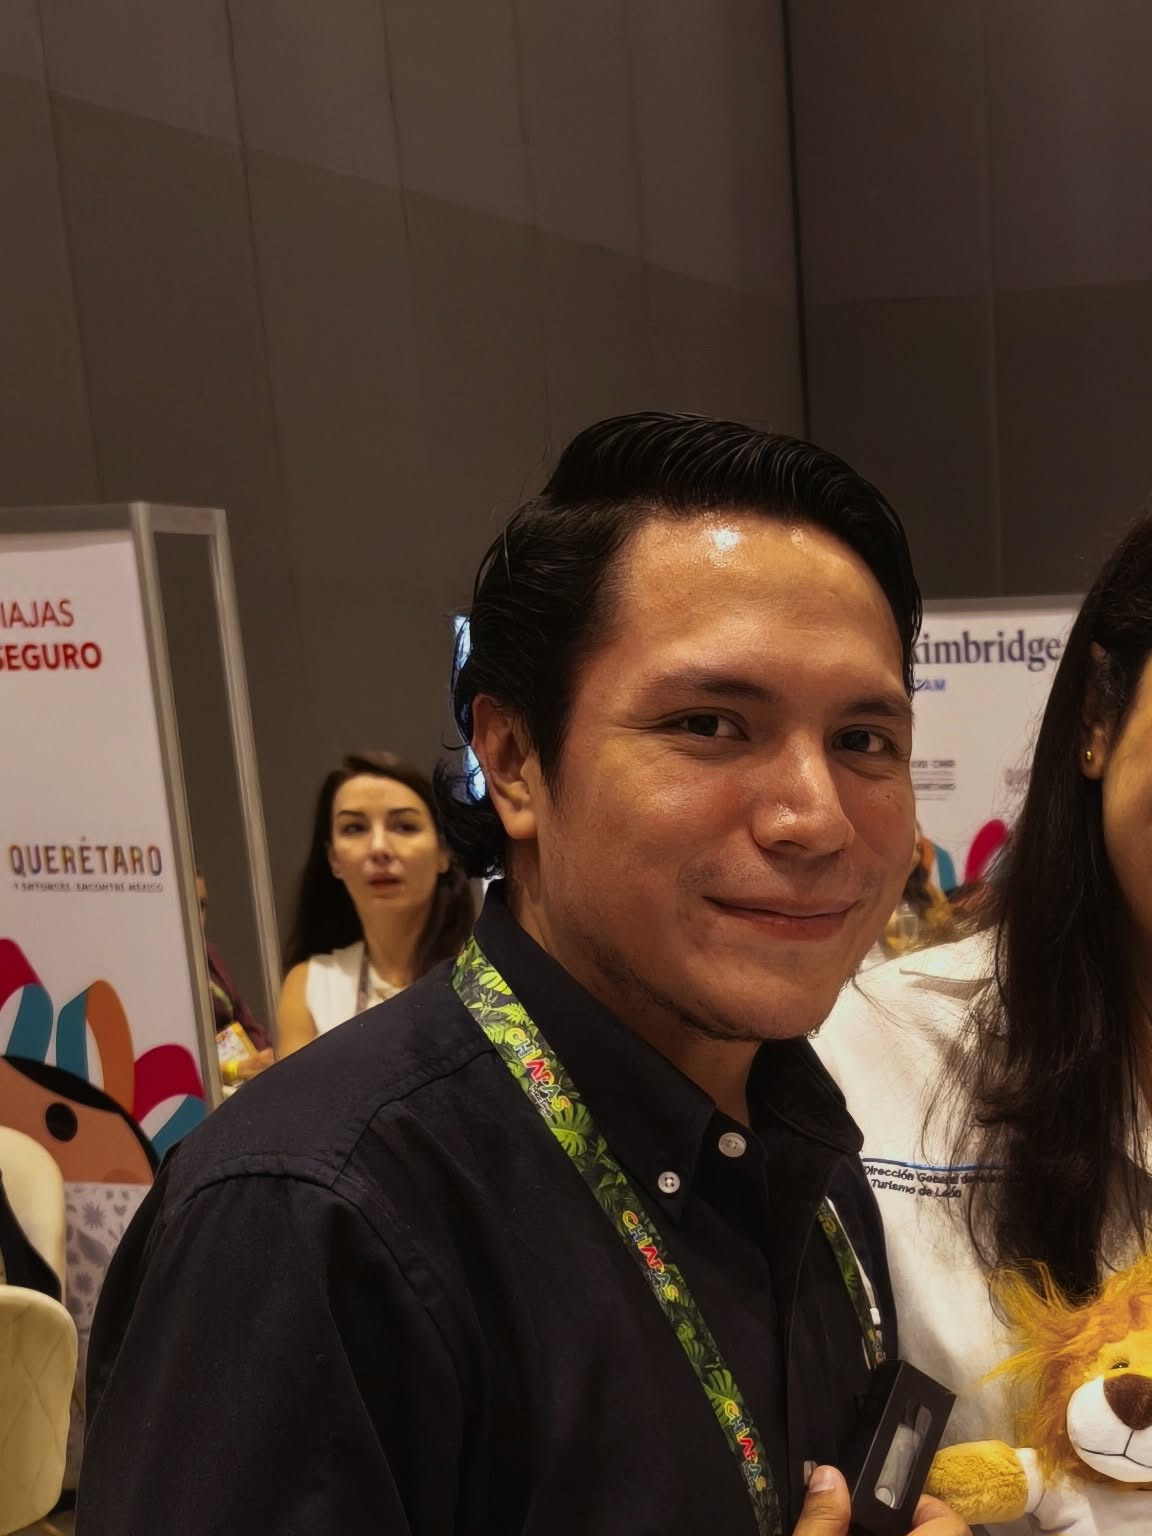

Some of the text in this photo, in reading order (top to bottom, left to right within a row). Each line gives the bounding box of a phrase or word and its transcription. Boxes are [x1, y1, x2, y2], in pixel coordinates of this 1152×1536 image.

[0, 598, 74, 628] IAJAS
[8, 835, 163, 877] QUERÉTARO
[870, 1178, 916, 1194] Turismo
[918, 1185, 932, 1197] de
